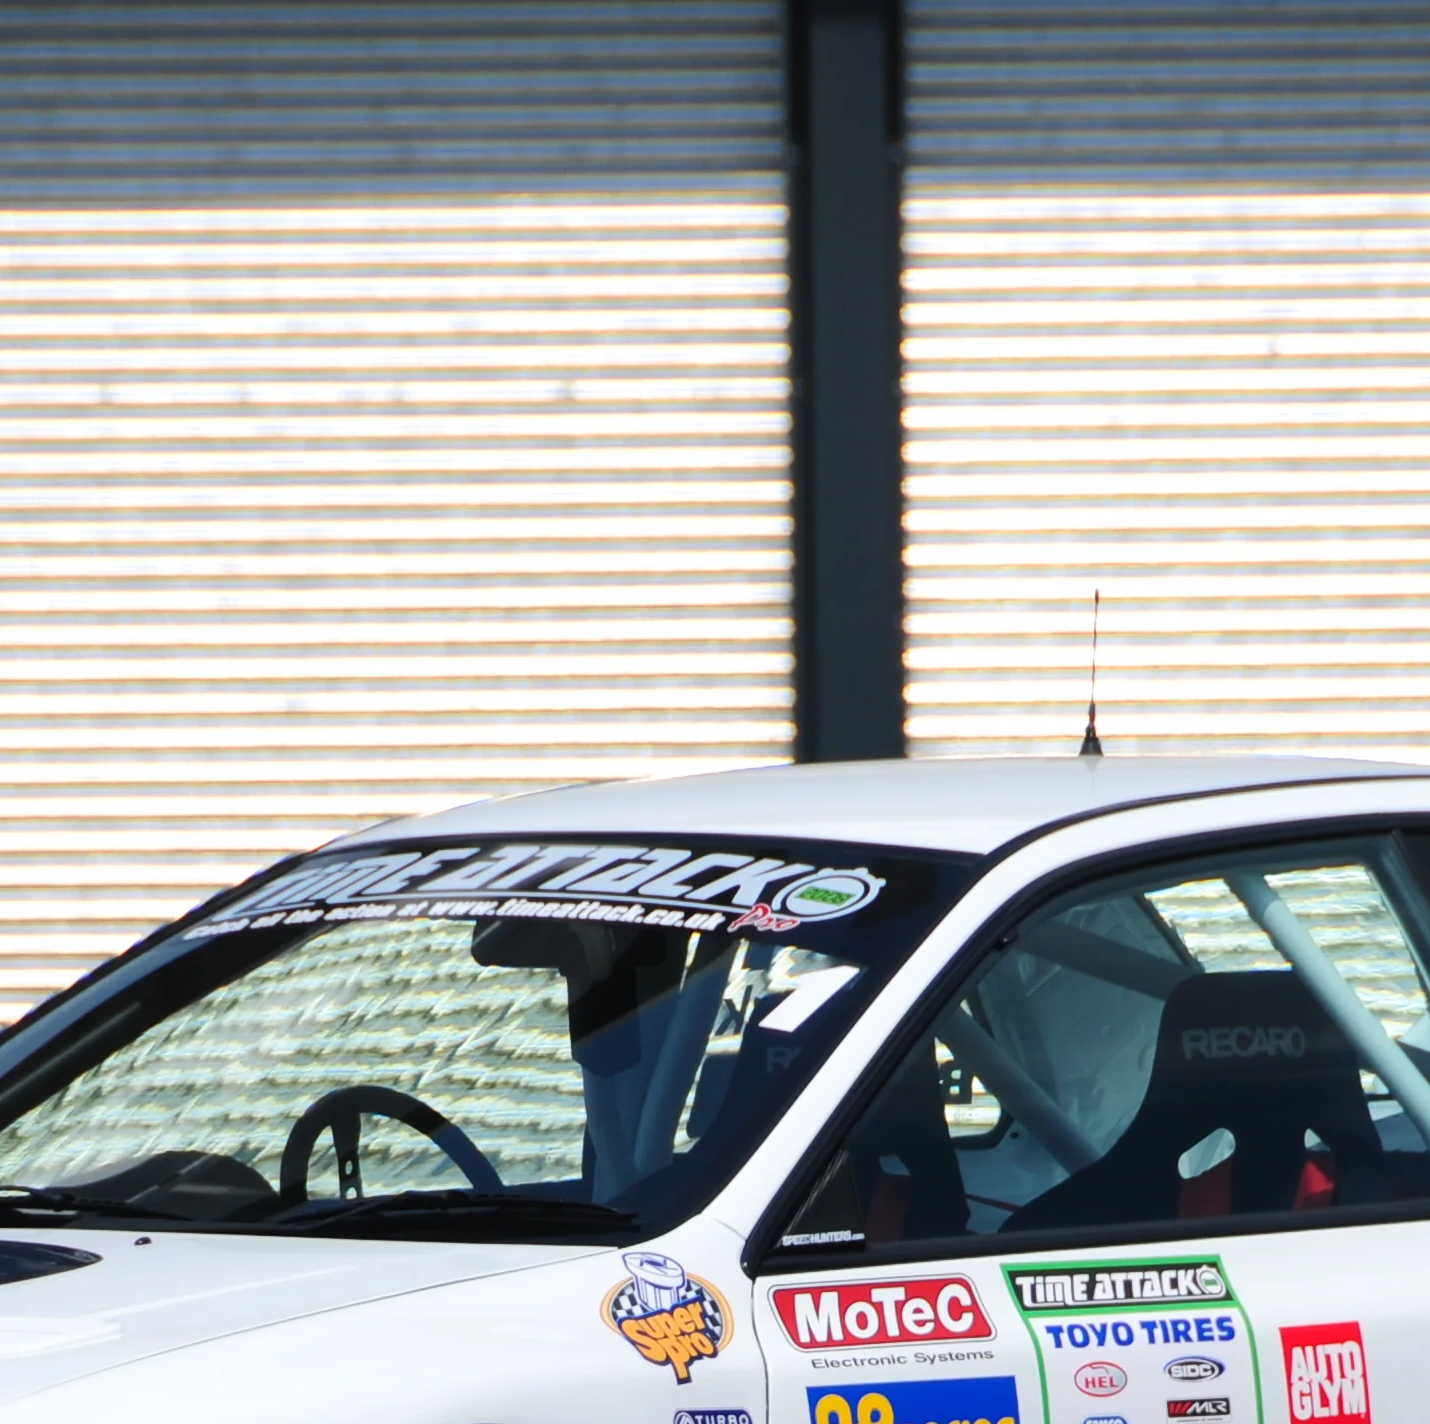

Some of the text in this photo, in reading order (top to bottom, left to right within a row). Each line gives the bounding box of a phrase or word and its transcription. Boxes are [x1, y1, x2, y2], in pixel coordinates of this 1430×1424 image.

[283, 909, 325, 925] the
[324, 903, 397, 921] action
[397, 900, 428, 917] at
[428, 898, 726, 931] www.timeattack.co.uk
[758, 965, 860, 1033] 1
[1182, 1025, 1306, 1060] RECARO
[1093, 1269, 1203, 1300] ATTACK
[794, 1283, 972, 1344] MoTeC
[1045, 1316, 1236, 1348] TOYO TIRES
[811, 1349, 995, 1370] Electronic Systems
[1170, 1364, 1212, 1377] SIDC
[1291, 1341, 1364, 1383] AUTO
[1084, 1376, 1119, 1388] HEL
[1291, 1377, 1367, 1420] GLYM
